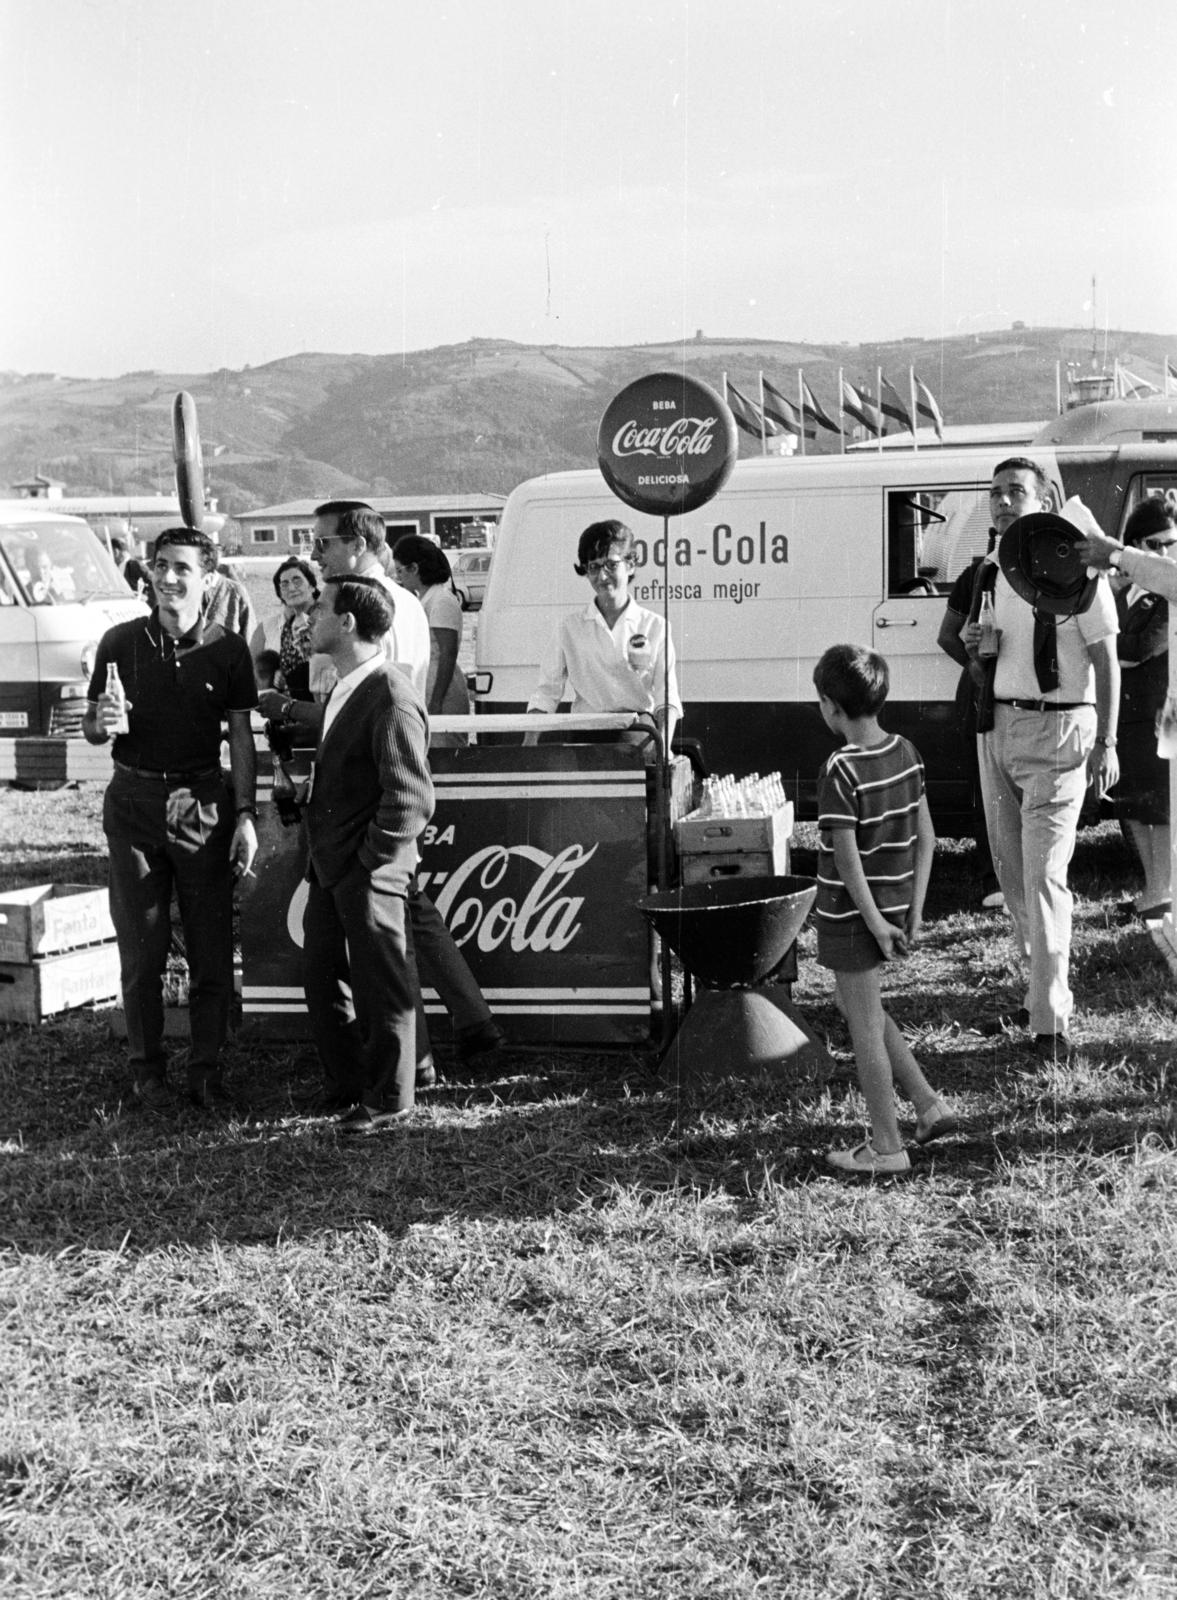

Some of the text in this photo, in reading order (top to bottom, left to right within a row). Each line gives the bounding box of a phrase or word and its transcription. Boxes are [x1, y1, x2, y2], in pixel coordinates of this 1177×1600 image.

[652, 400, 677, 410] BEBA
[612, 417, 718, 457] Coca-Cola
[638, 475, 690, 485] DELICIOSA
[633, 521, 788, 568] oca-Cola
[713, 578, 761, 604] mejor
[424, 824, 456, 845] BA
[53, 911, 97, 943] Fanta
